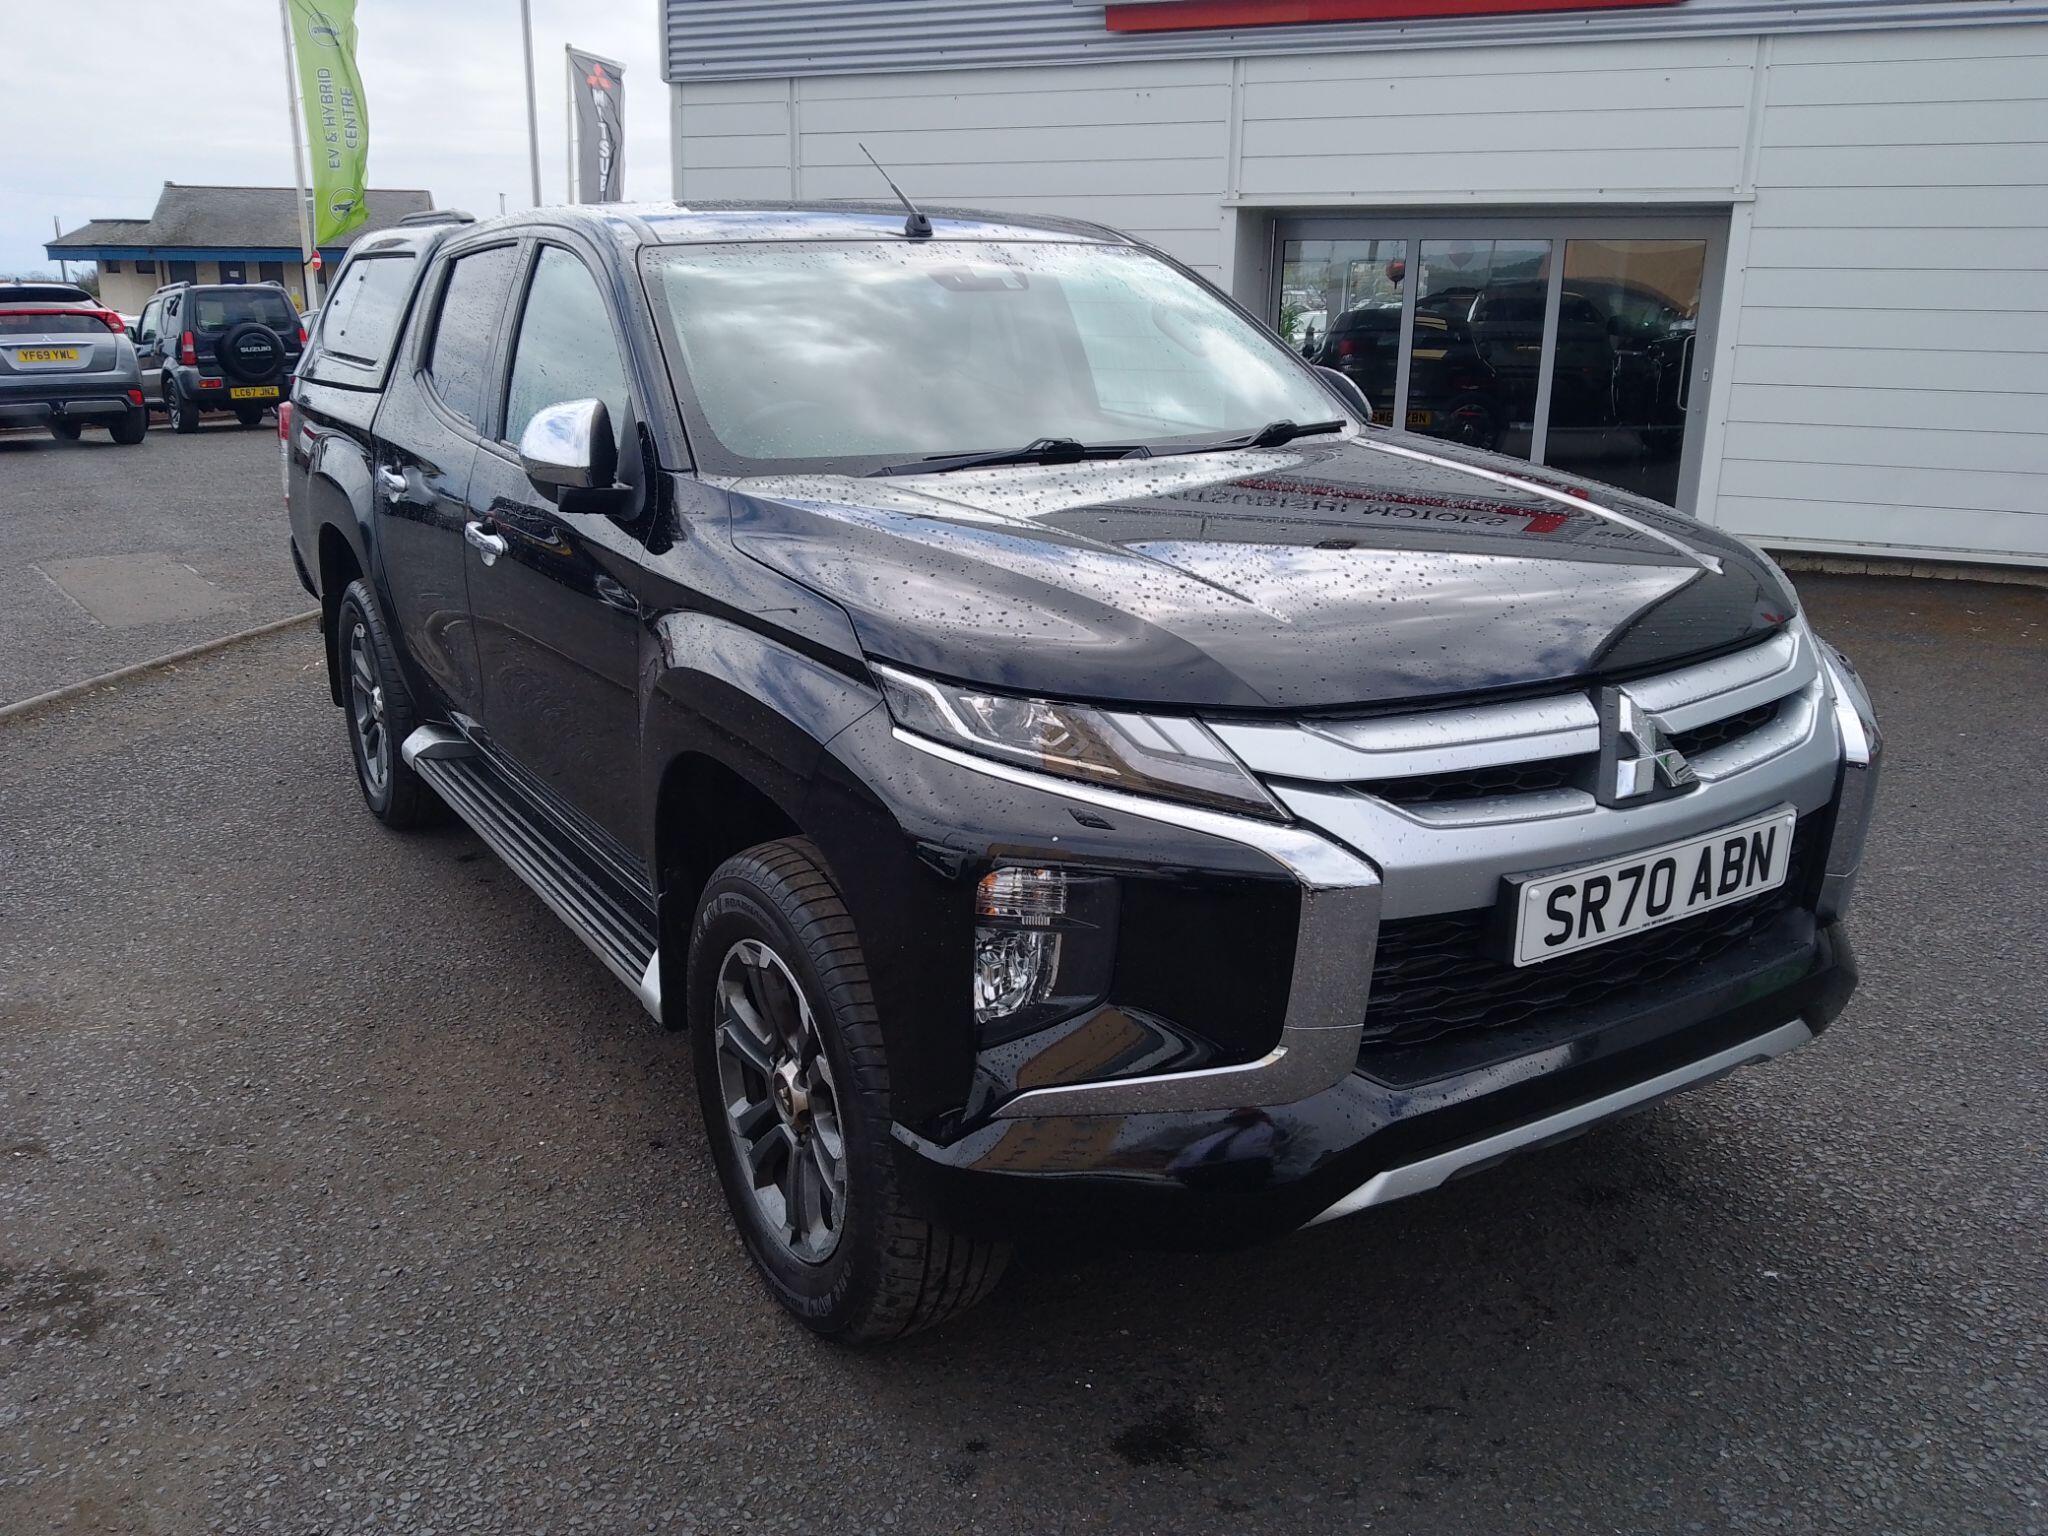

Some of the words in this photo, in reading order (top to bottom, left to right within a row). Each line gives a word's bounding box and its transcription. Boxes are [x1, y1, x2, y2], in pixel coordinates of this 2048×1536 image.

[317, 68, 337, 127] HYBRID
[340, 86, 358, 149] CENTRE
[325, 130, 338, 142] &
[329, 149, 341, 169] EV
[22, 351, 51, 360] YF69
[50, 350, 74, 359] YWL
[240, 345, 272, 353] SUZUKI
[1544, 857, 1677, 947] SR70
[1687, 825, 1777, 906] ABN
